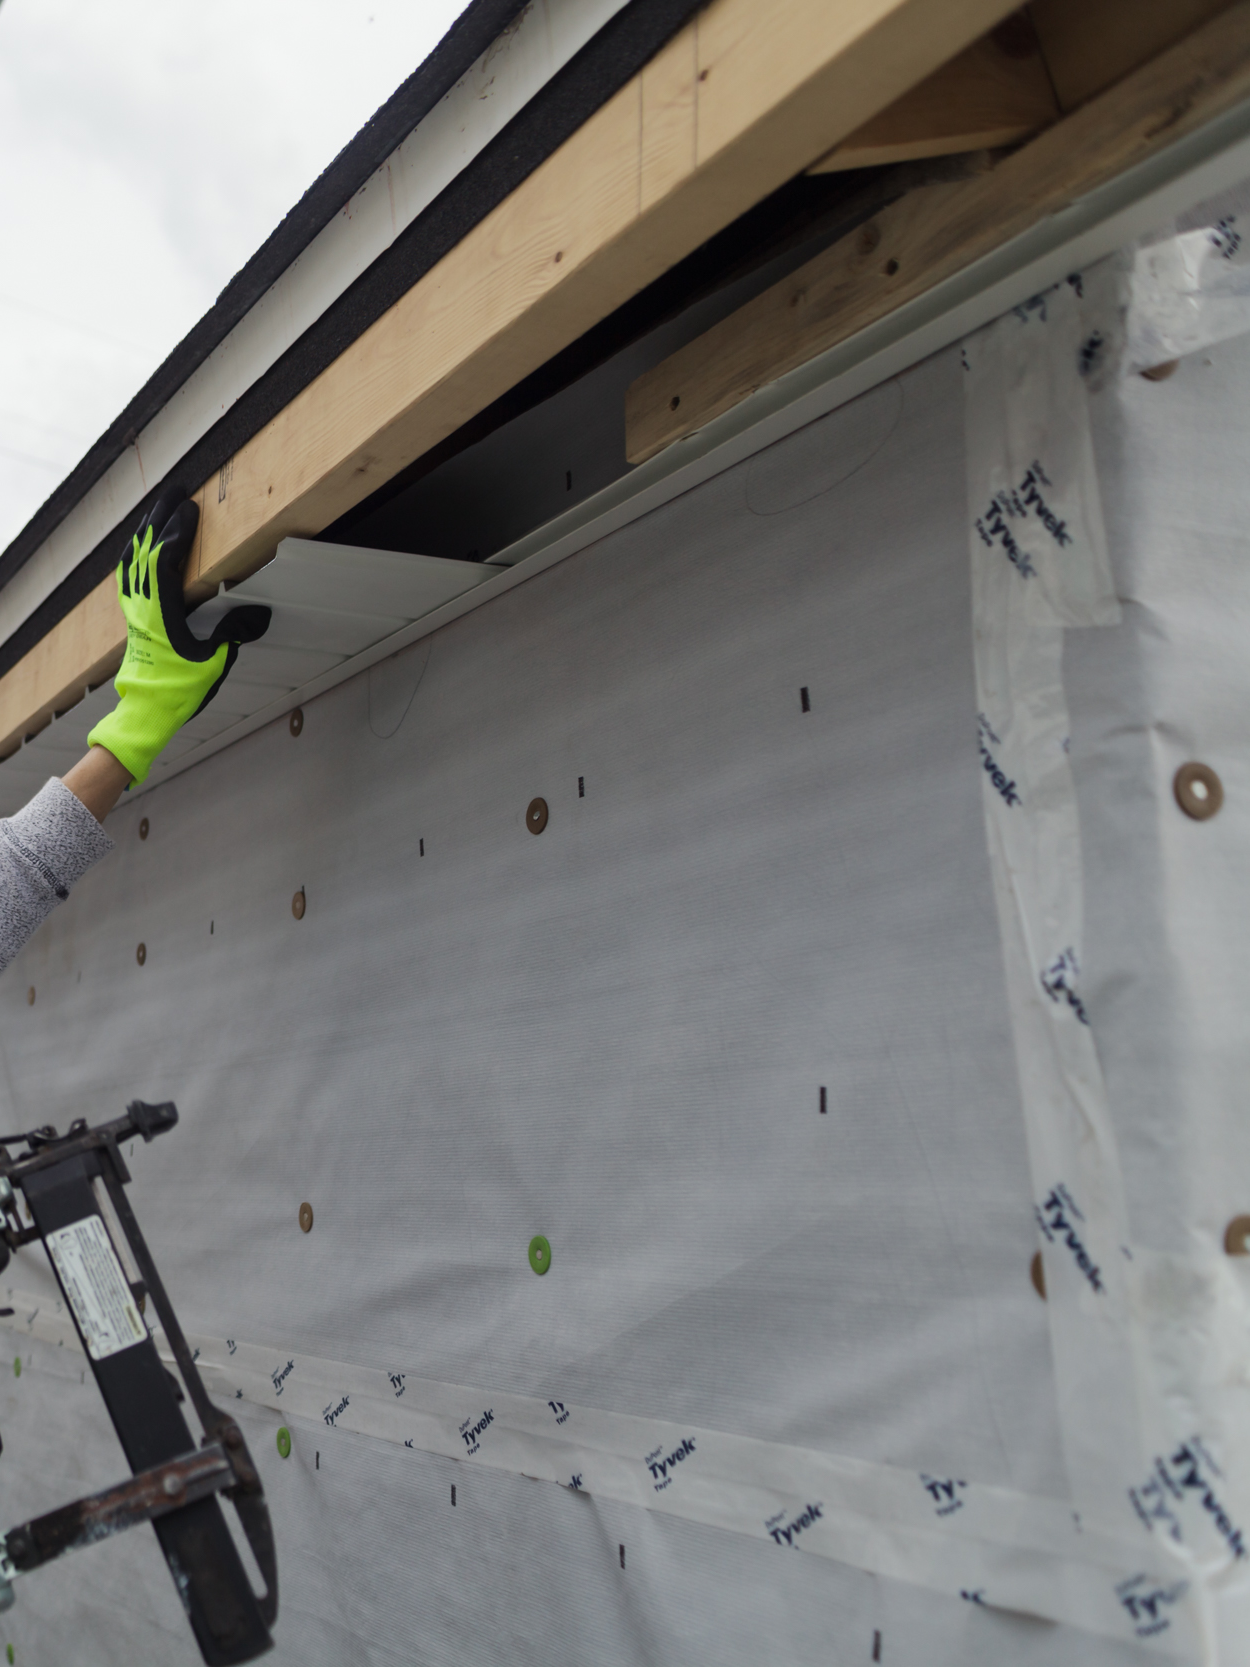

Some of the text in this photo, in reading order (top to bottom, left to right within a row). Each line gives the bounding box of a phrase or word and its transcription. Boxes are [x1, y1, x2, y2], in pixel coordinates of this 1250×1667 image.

[1020, 469, 1073, 549] Tyvek
[985, 499, 1038, 580] Tyvek
[1044, 1190, 1107, 1295] Tyvek
[273, 1359, 294, 1389] Tyvek
[324, 1395, 350, 1427] Tyvek
[462, 1408, 495, 1446] Tyvek
[556, 1410, 570, 1425] Tape
[467, 1443, 480, 1456] Tape
[648, 1436, 697, 1480] Tyvek
[654, 1477, 673, 1493] Tape
[1171, 1441, 1249, 1560] Tyvek
[770, 1502, 824, 1546] Tyvek
